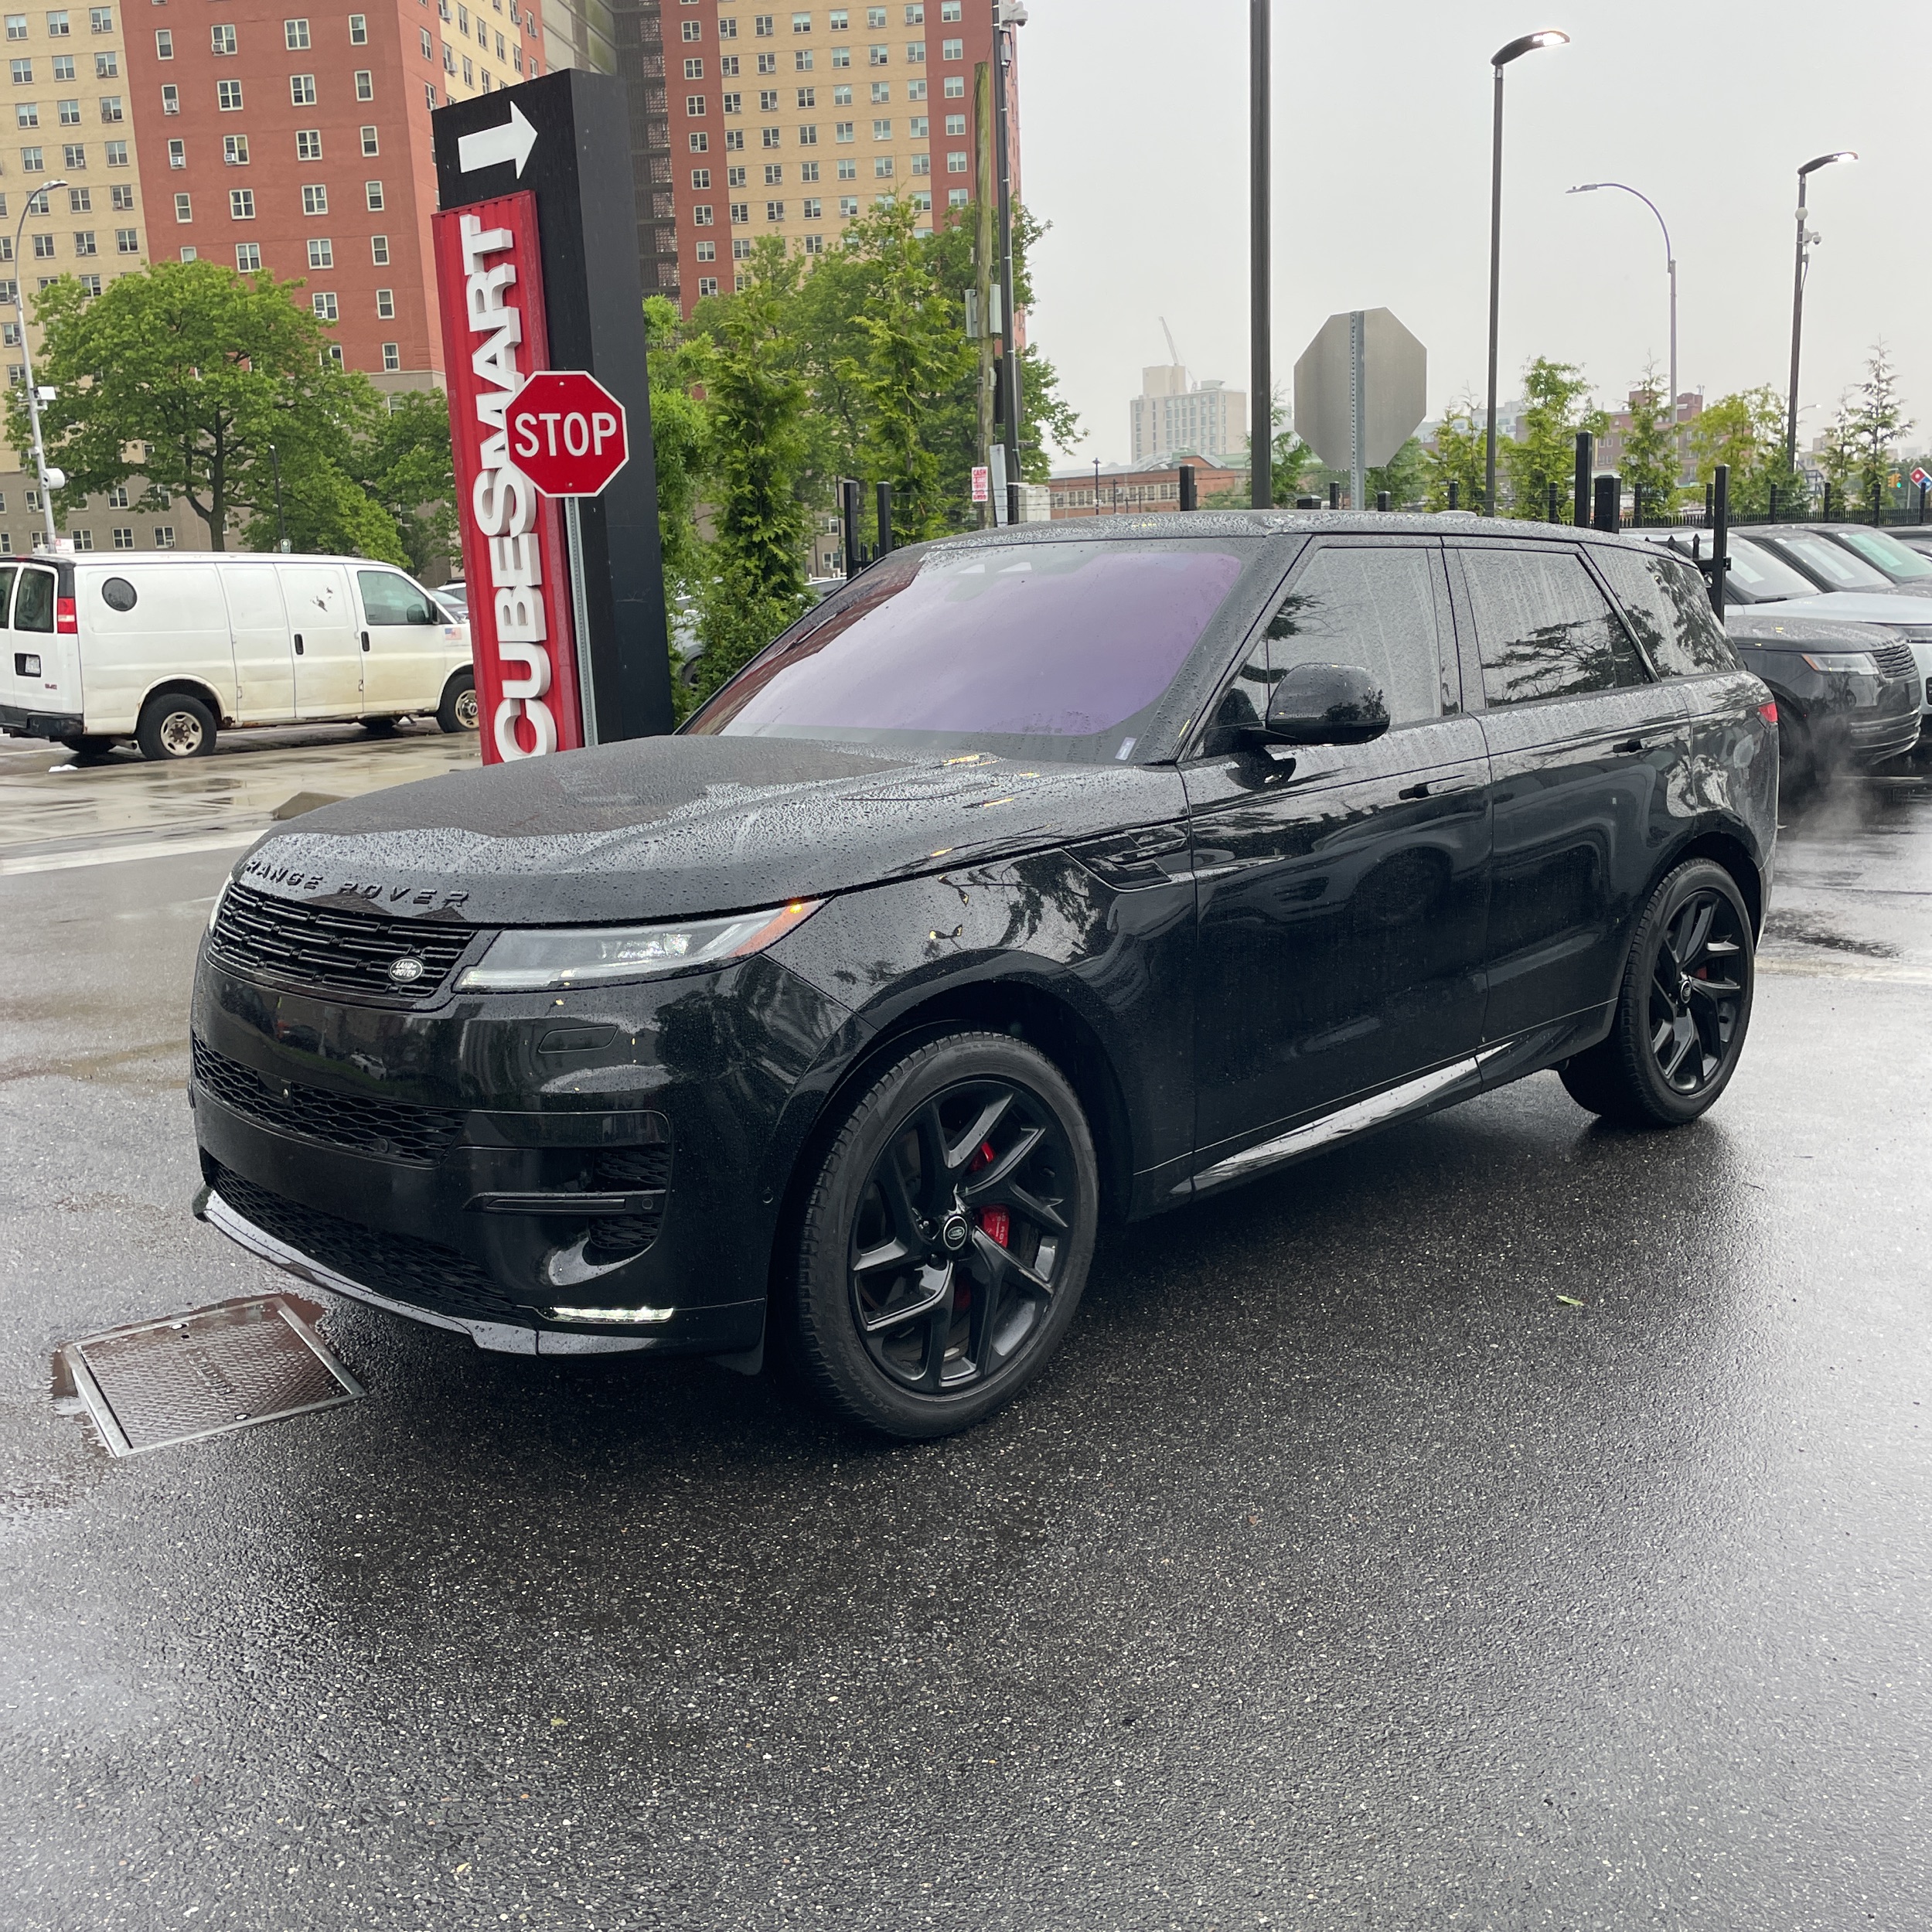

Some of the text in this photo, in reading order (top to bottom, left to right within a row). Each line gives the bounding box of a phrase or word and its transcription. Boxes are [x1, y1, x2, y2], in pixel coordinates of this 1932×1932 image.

[514, 411, 617, 458] STOP
[459, 214, 555, 763] CUBESMART
[245, 860, 469, 908] RANGE ROVER
[394, 969, 417, 977] ROVER
[395, 961, 414, 969] LAND
